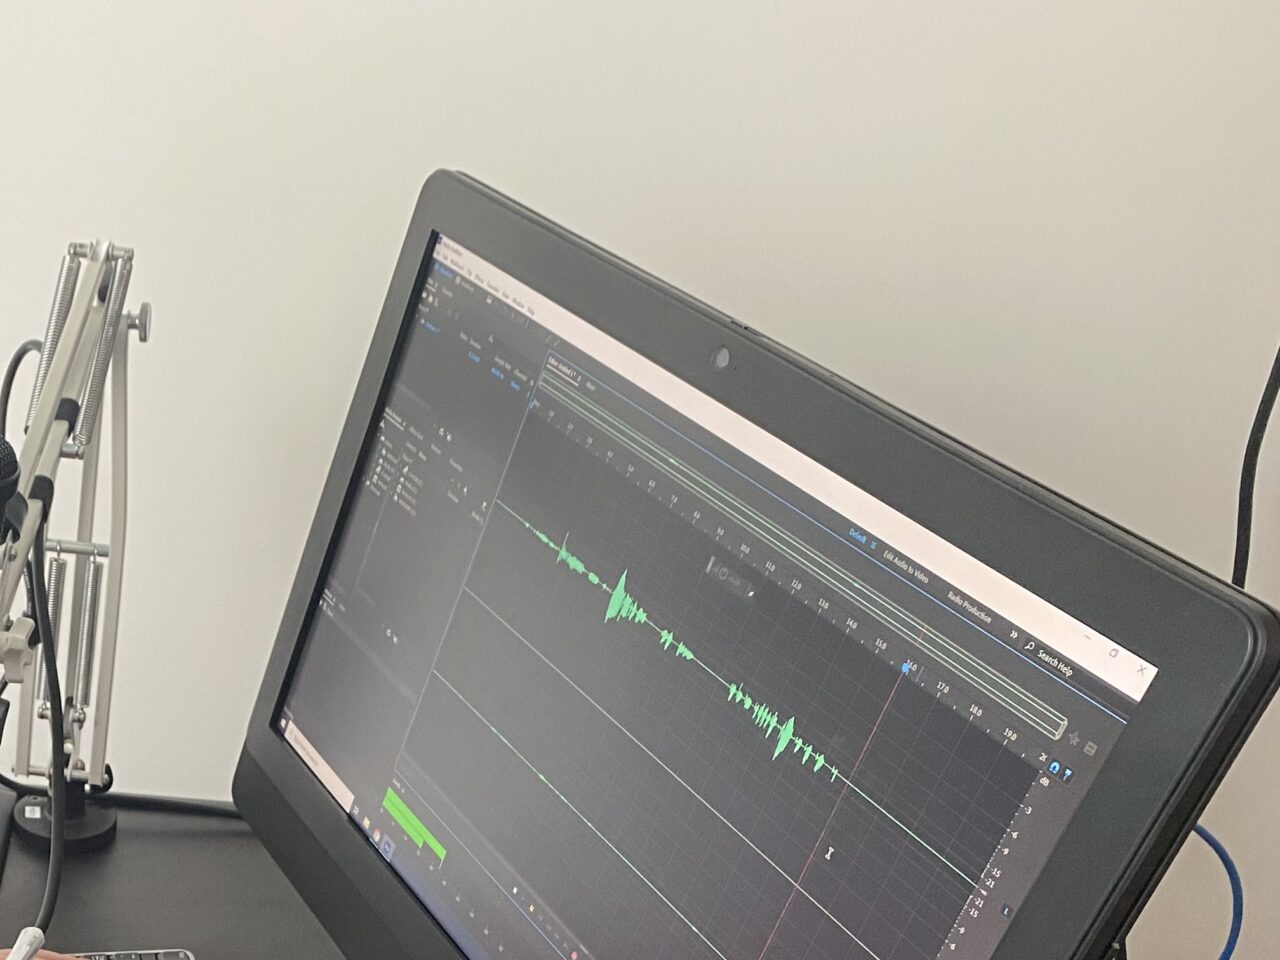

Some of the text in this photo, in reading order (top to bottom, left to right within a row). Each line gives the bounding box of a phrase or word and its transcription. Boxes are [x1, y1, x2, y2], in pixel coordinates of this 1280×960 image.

[848, 528, 866, 544] Default
[884, 550, 894, 562] Edit
[894, 558, 908, 572] Audio
[914, 569, 928, 584] Video
[948, 590, 992, 624] Radio Production
[846, 618, 858, 629] 14.0
[876, 638, 887, 650] 15.0
[1038, 649, 1073, 678] Search Help
[936, 681, 950, 694] 17.0
[970, 704, 982, 716] 18.0
[1004, 728, 1018, 741] 19.0
